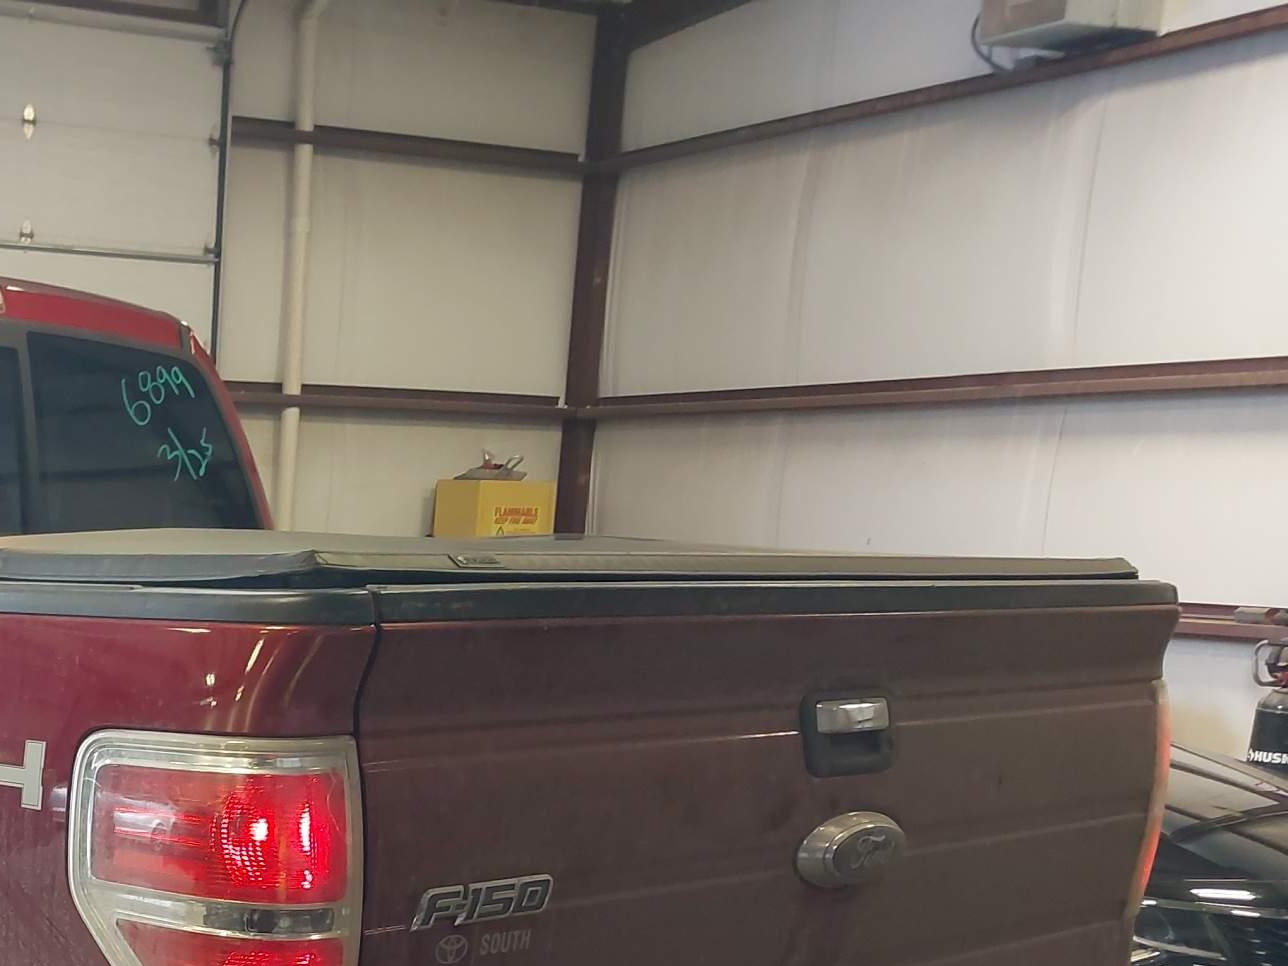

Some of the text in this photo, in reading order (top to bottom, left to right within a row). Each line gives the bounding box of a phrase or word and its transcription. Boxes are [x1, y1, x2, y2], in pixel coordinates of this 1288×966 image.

[120, 365, 196, 426] 6899
[410, 873, 554, 932] F-150
[480, 928, 532, 956] SOUTH
